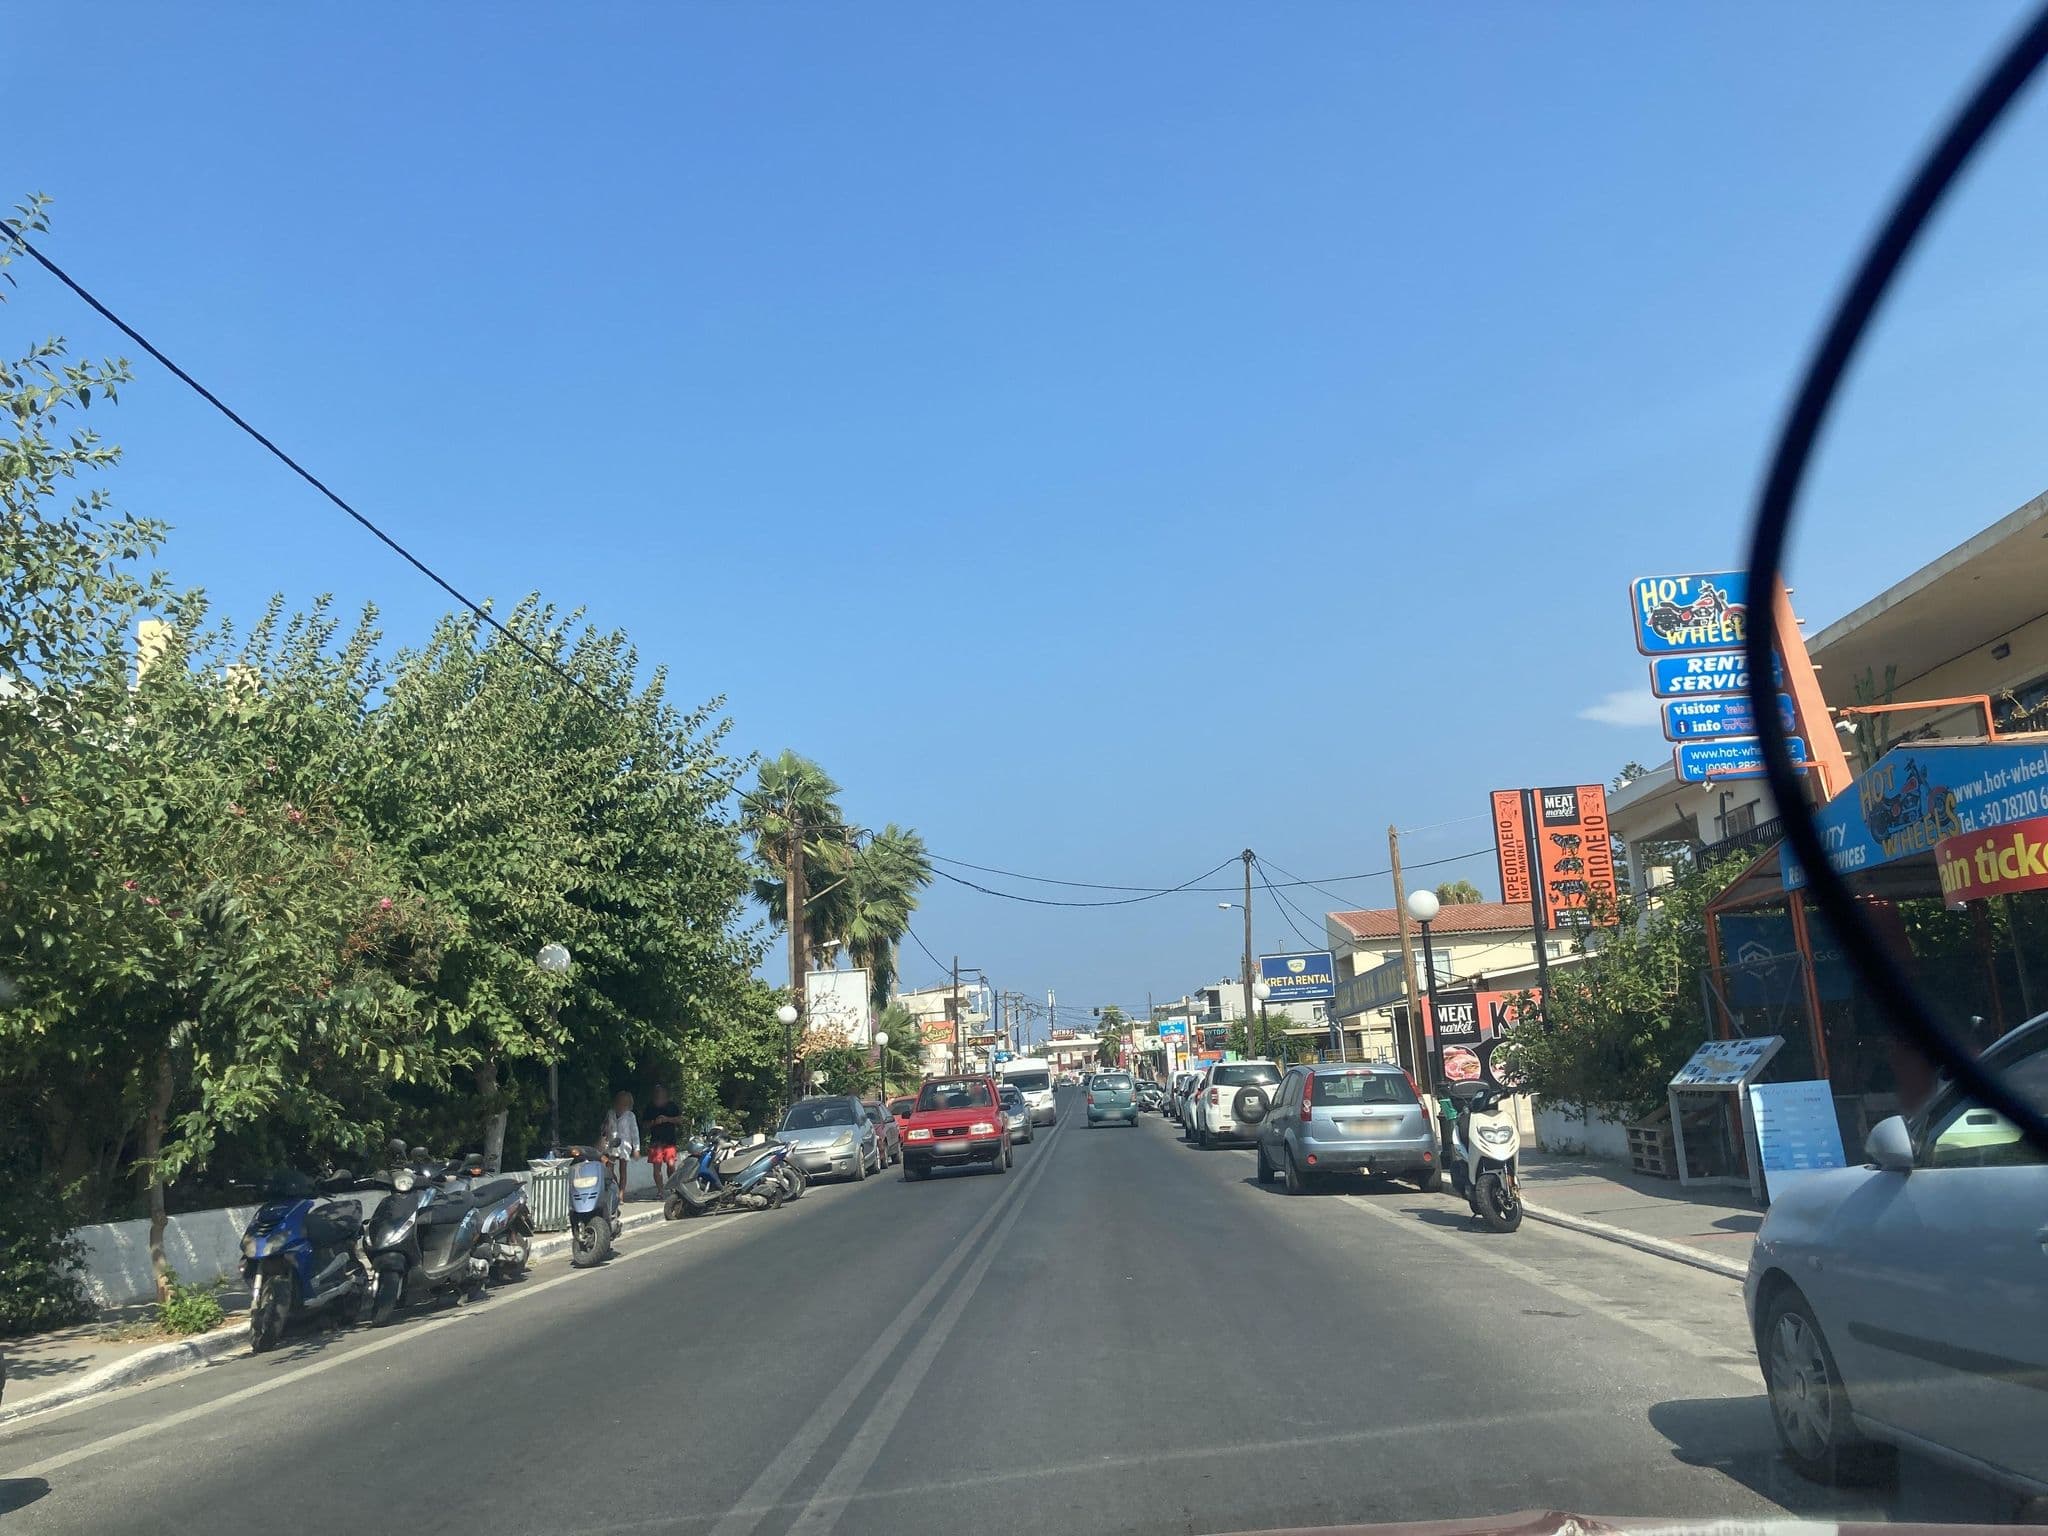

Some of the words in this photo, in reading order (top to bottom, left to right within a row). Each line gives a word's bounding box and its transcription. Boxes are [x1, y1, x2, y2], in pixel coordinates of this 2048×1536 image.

[1640, 577, 1690, 613] HOT
[1665, 618, 1747, 646] WHEEL
[1669, 673, 1749, 690] SERVIC
[1674, 702, 1720, 715] visitor
[1692, 719, 1721, 732] info
[1545, 795, 1574, 810] MEAT
[1860, 764, 1897, 820] HOT
[1546, 807, 1575, 817] market
[1883, 793, 1962, 858] WHEELS
[1958, 812, 1979, 834] Tel.
[1980, 802, 2001, 827] +30
[2005, 792, 2039, 822] 28210
[1501, 820, 1520, 900] ΚΡΕΟΠΩΛΕΙΟ
[1516, 839, 1527, 873] MARKET
[1938, 850, 1971, 894] ain
[1975, 833, 2048, 884] tick
[1520, 873, 1529, 899] MEAT
[1264, 975, 1295, 988] KRETA
[1296, 973, 1332, 985] RENTAL
